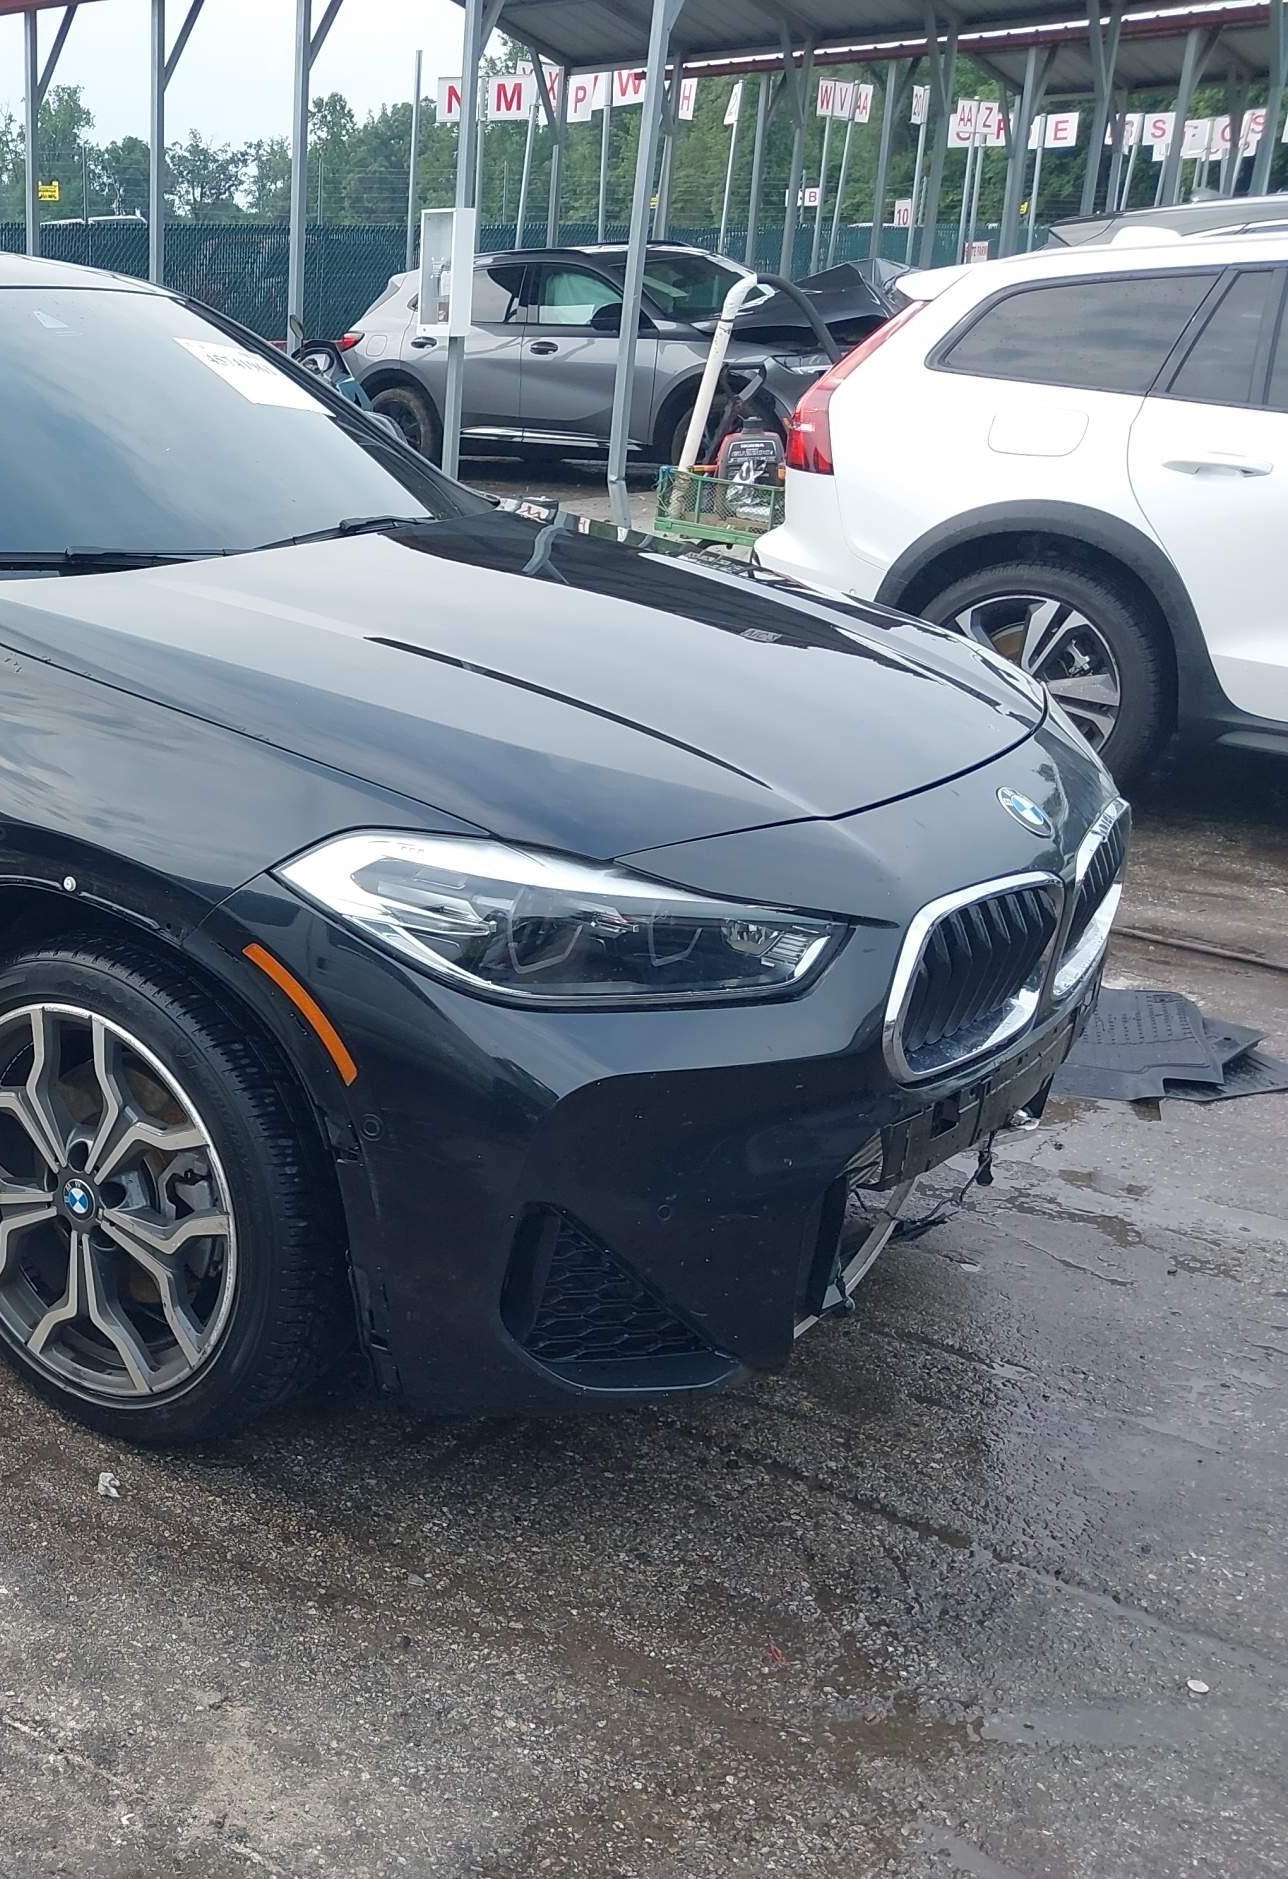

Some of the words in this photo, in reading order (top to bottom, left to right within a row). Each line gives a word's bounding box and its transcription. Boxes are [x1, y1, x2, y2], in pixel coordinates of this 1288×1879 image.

[617, 69, 643, 97] W
[495, 82, 523, 112] M
[573, 85, 588, 114] P
[680, 83, 693, 112] H
[820, 85, 833, 110] W
[839, 87, 850, 111] V
[982, 106, 994, 128] Z
[1150, 119, 1167, 138] S
[1053, 119, 1069, 141] E
[896, 208, 909, 225] 10
